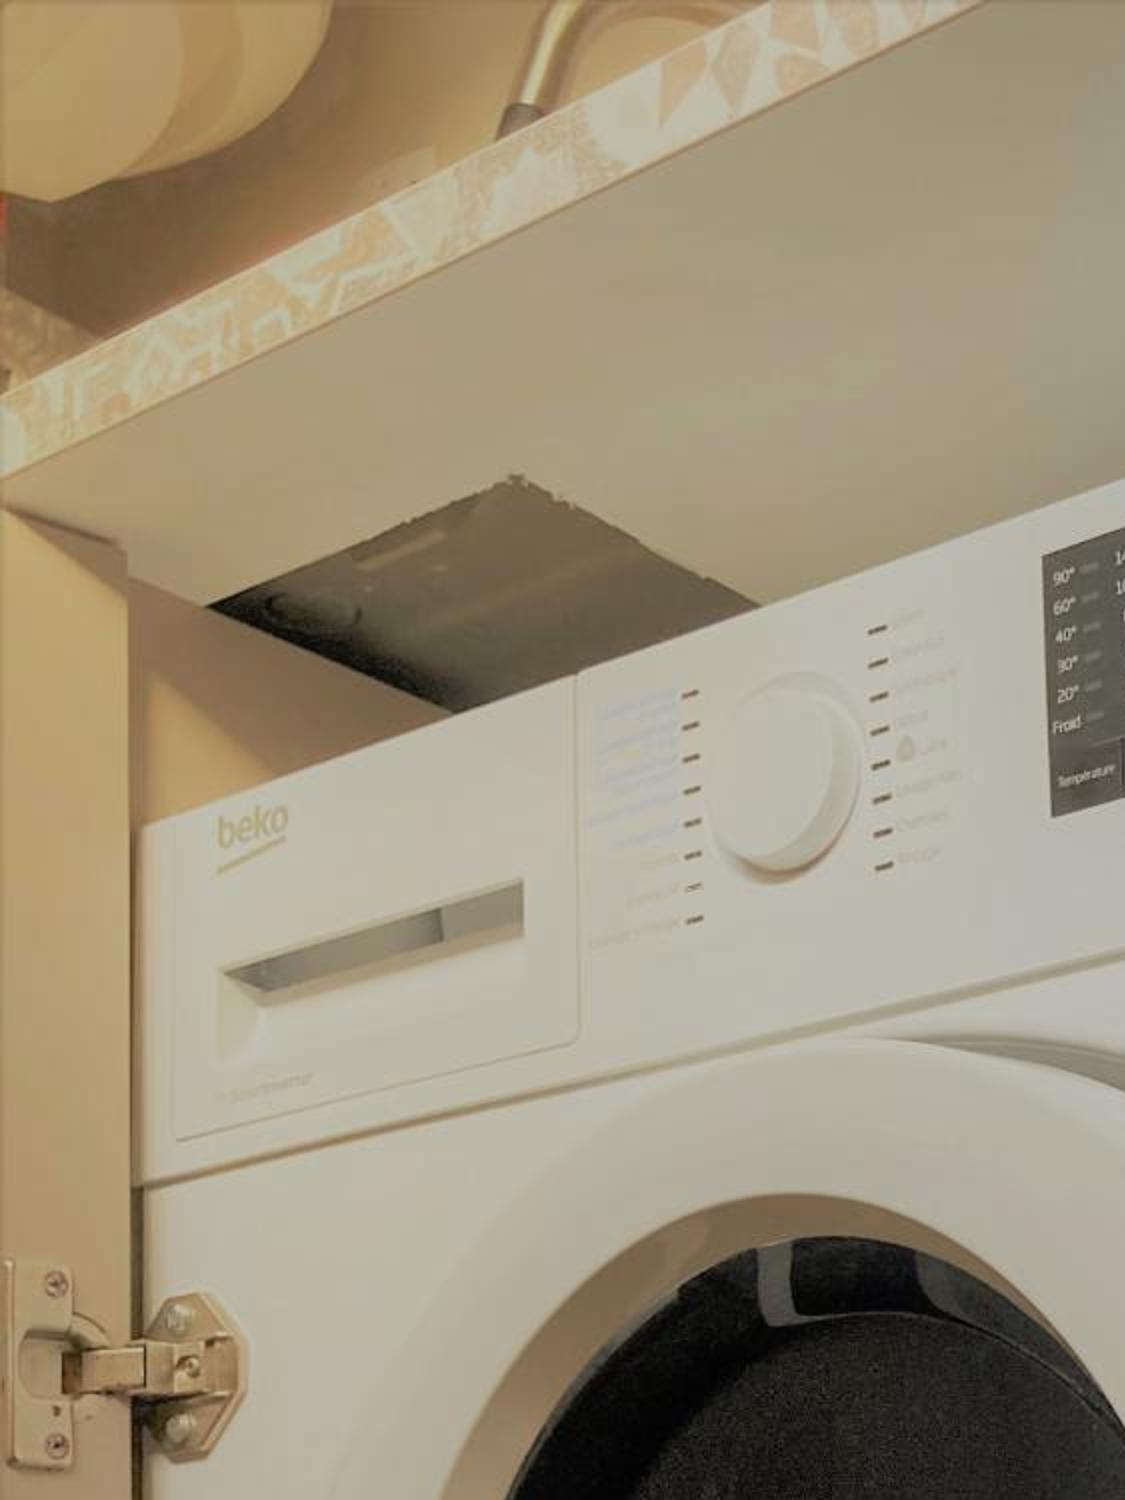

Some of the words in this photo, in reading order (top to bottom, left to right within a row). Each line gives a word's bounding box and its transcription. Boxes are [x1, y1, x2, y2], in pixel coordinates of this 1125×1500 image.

[1053, 566, 1076, 587] 90°
[1055, 624, 1078, 644] 40°
[1051, 712, 1082, 735] Froid
[1056, 762, 1117, 789] Température
[218, 804, 288, 849] beko
